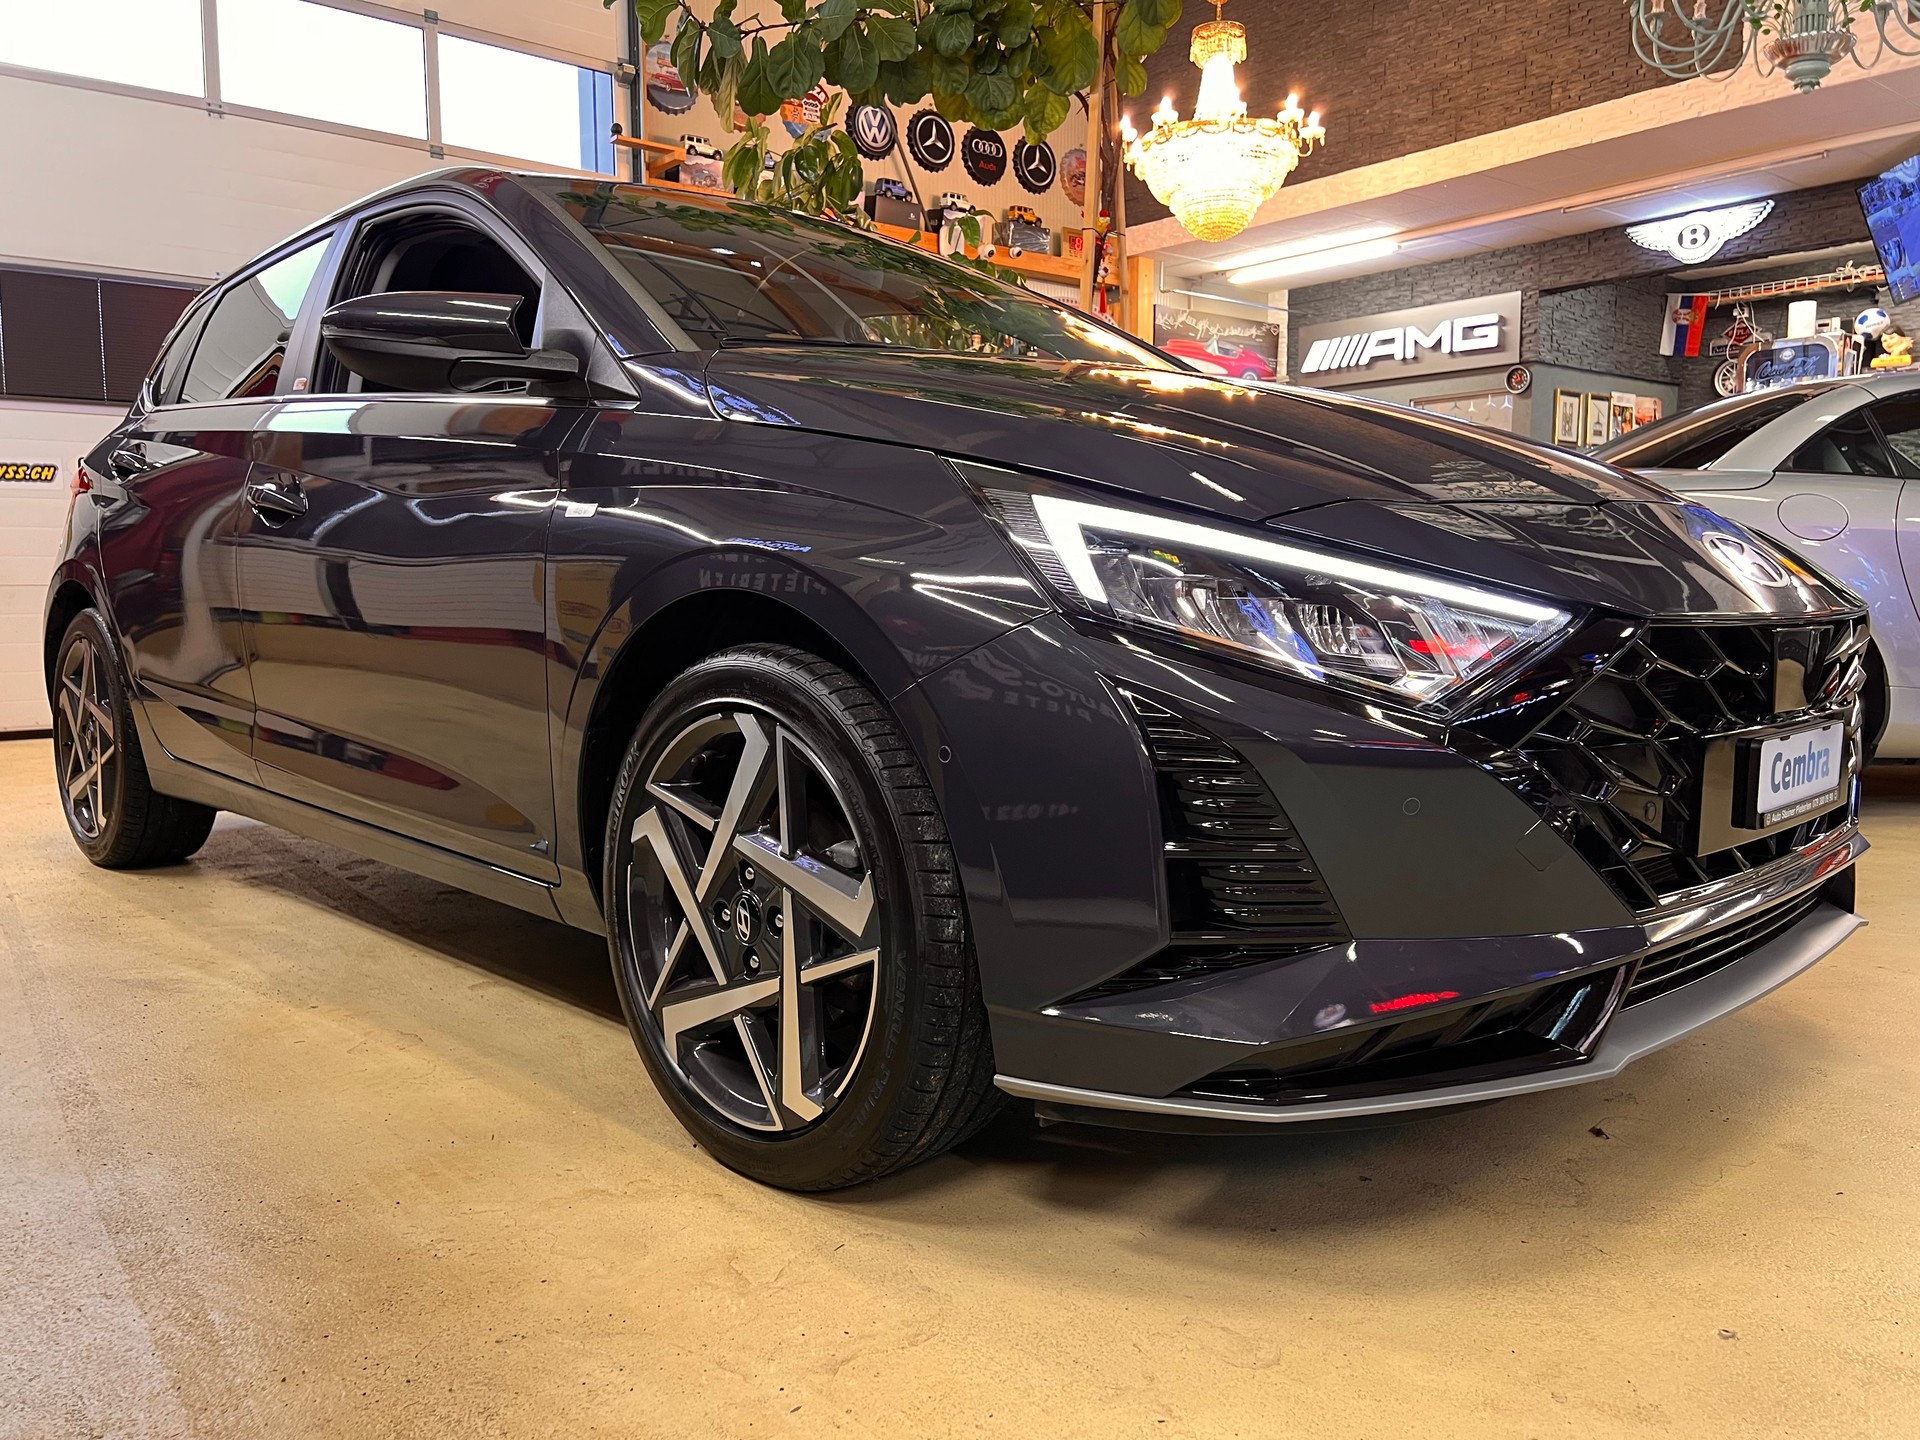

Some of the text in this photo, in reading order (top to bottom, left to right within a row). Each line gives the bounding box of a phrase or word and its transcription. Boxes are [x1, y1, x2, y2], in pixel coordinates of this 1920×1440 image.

[978, 160, 997, 171] Audi
[1358, 313, 1499, 366] AMG
[1770, 740, 1830, 794] Cembra
